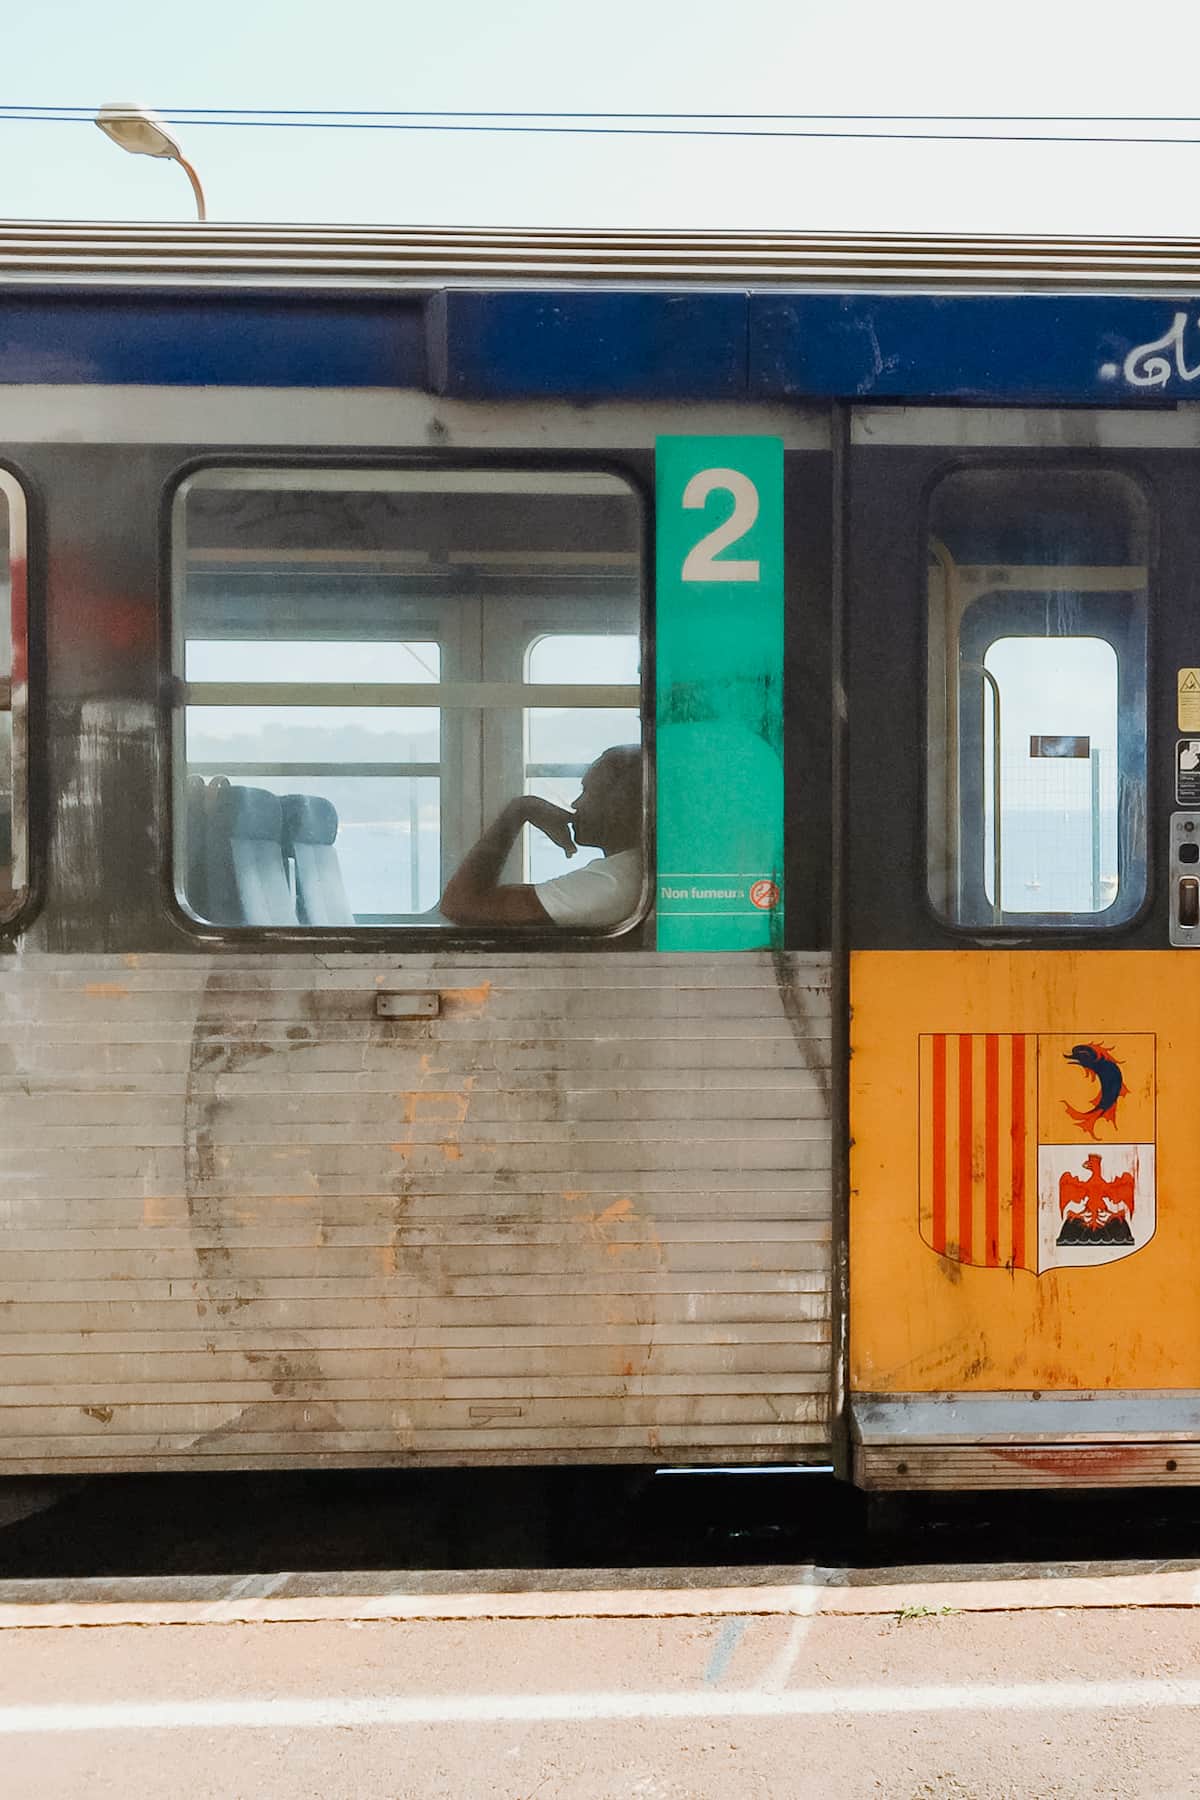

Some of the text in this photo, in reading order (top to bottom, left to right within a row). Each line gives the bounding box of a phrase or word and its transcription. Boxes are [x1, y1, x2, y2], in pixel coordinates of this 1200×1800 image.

[682, 468, 759, 581] 2
[661, 887, 745, 899] Non fumeurs
